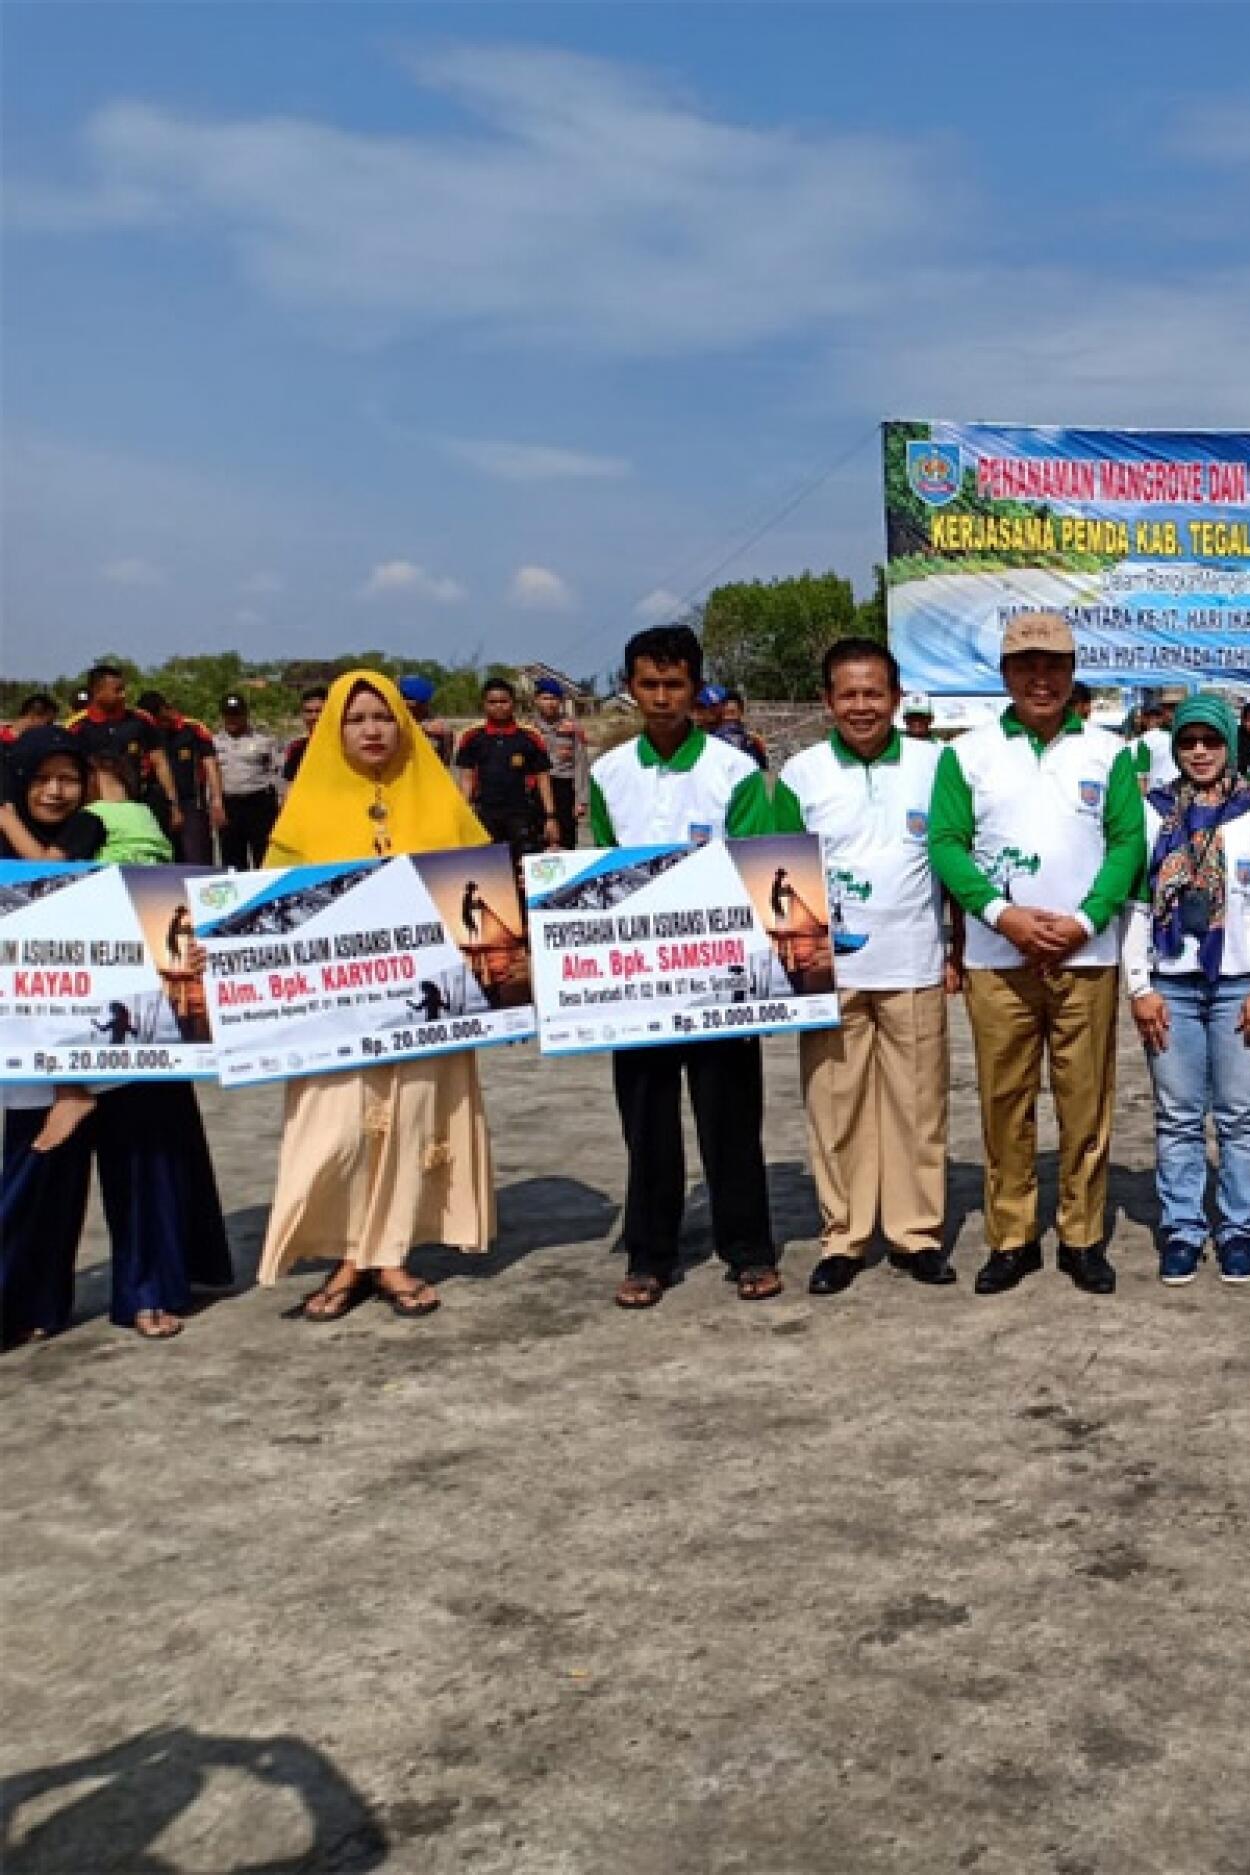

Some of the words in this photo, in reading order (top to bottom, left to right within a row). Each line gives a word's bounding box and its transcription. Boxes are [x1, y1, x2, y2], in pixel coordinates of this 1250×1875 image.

[978, 457, 1094, 500] PENANAMAN
[1099, 459, 1201, 501] MANGROVE
[1208, 461, 1244, 502] DAN
[930, 515, 1055, 552] KERJASAMA
[1062, 518, 1129, 553] PEMDA
[1136, 522, 1182, 555] KAB.
[1187, 607, 1222, 631] HARI
[1080, 646, 1111, 668] DAN
[1112, 646, 1146, 668] HUT
[1151, 646, 1211, 669] ARMADA
[543, 917, 616, 950] PENYERAHAN
[618, 914, 651, 941] KLAIM
[653, 910, 707, 939] ASURANSI
[709, 906, 753, 932] NELAYAN
[22, 940, 85, 966] ASURANSI
[90, 940, 144, 966] NELAYAN
[210, 944, 291, 977] PENYERAHAN
[294, 937, 331, 966] KLAIM
[334, 928, 392, 959] ASURANSI
[394, 921, 444, 951] NELAYAN
[562, 953, 604, 981] Alm.
[609, 947, 654, 981] Bpk.
[658, 937, 745, 971] SAMSURI
[13, 971, 92, 998] KAYAD
[218, 980, 263, 1007] Alm.
[269, 971, 317, 1003] Bpk.
[321, 955, 416, 992] KARYOTO
[672, 1013, 698, 1034] Rp.
[361, 1036, 388, 1058] Rp.
[34, 1051, 63, 1075] Rp.
